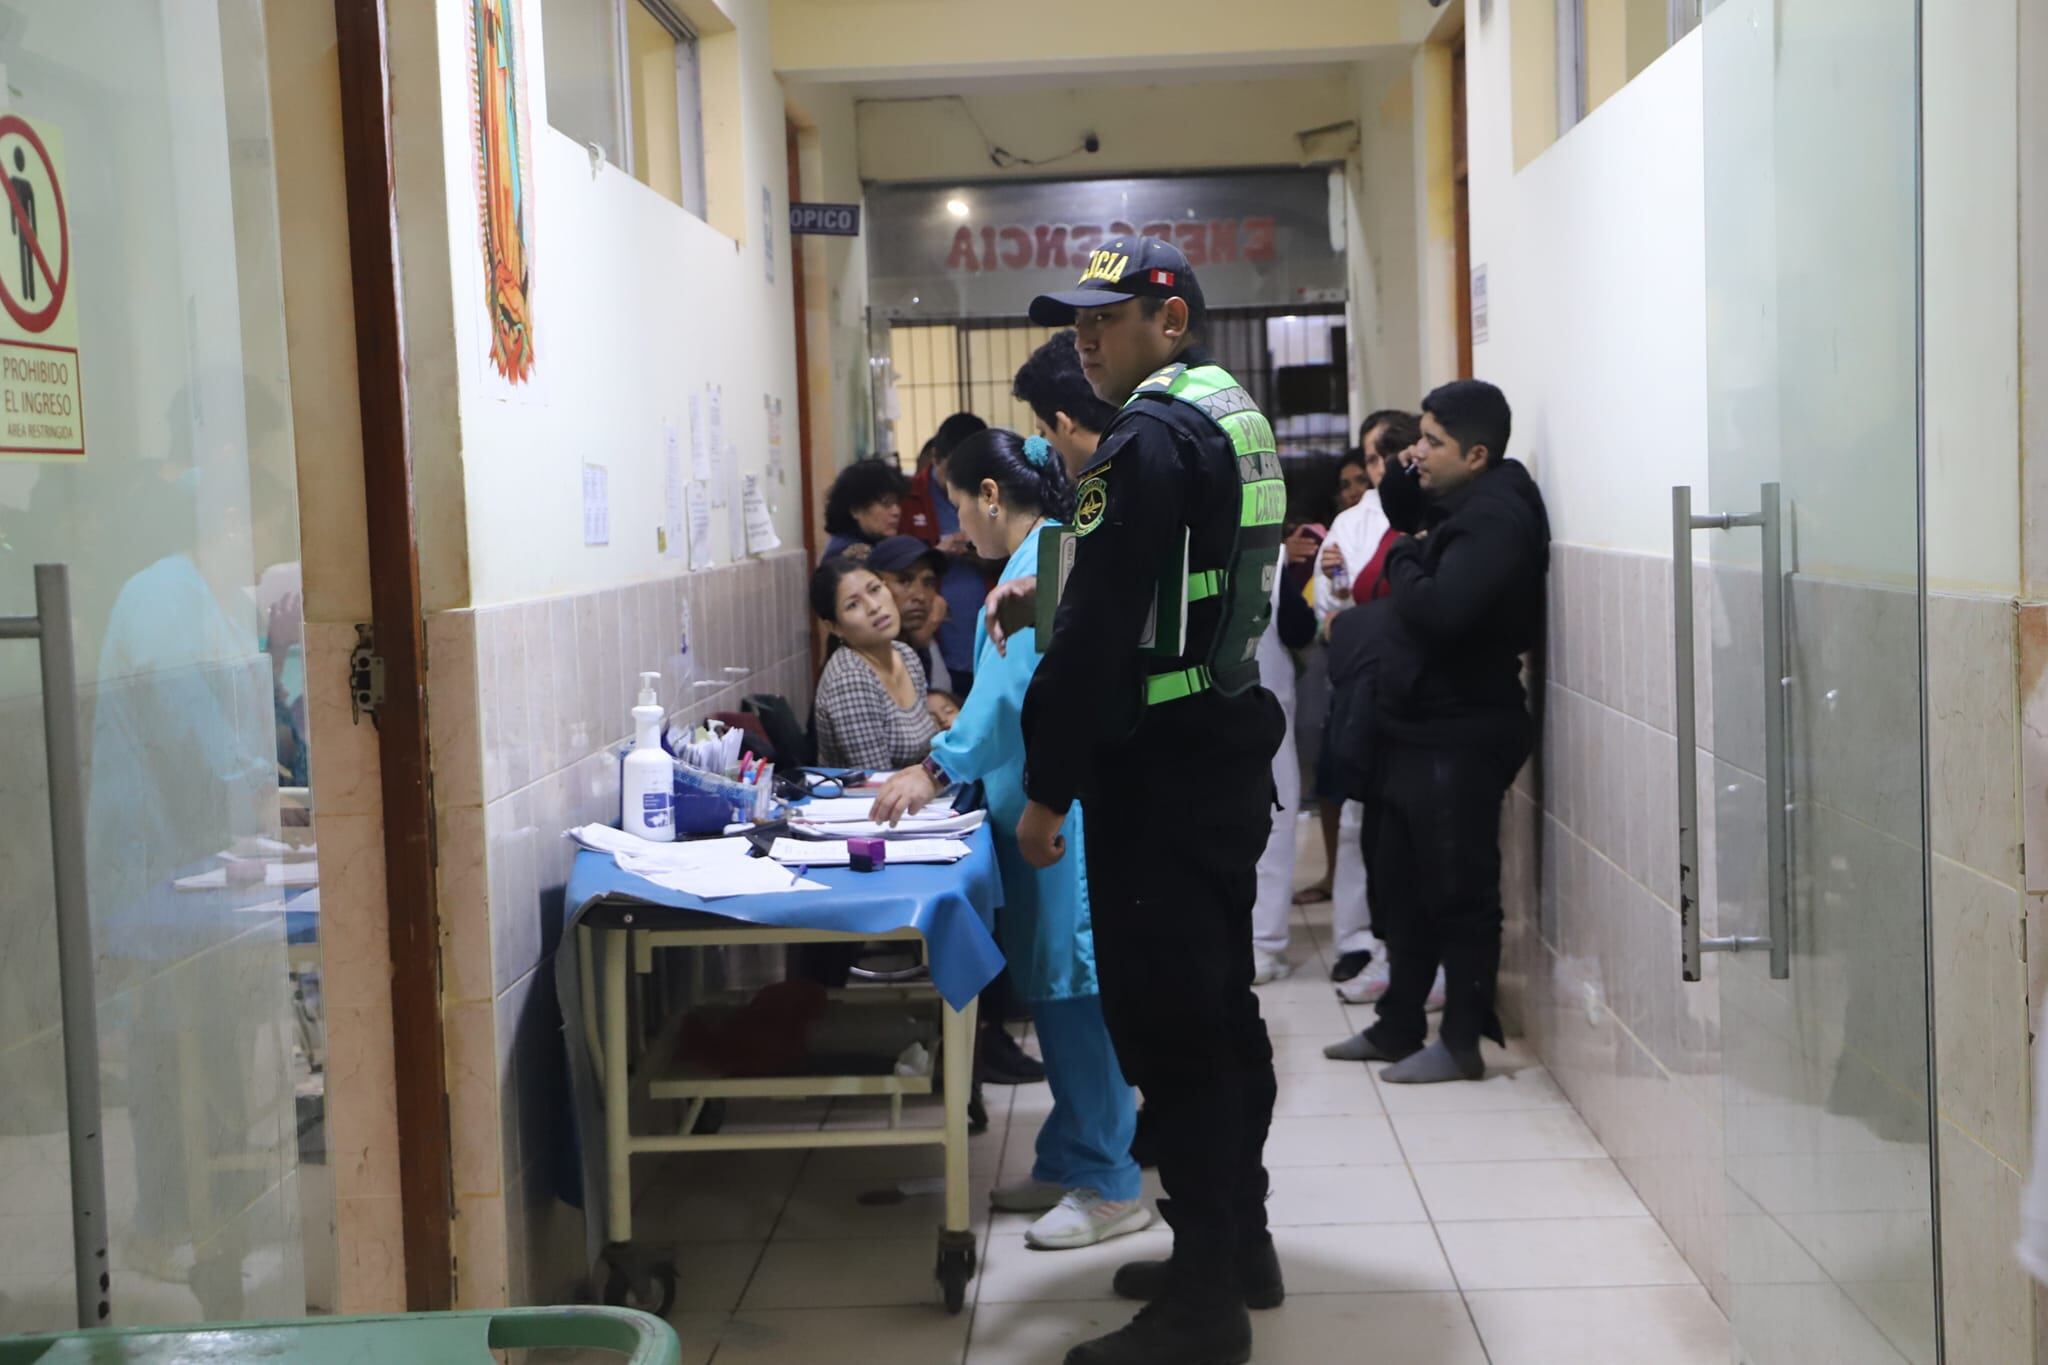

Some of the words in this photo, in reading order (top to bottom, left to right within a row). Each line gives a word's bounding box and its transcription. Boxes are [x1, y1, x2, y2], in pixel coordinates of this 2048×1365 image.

[3, 356, 69, 385] PROHIBIDO
[5, 389, 20, 413] EL
[21, 391, 72, 416] INGRESO
[28, 424, 73, 439] RESTRINGIDA
